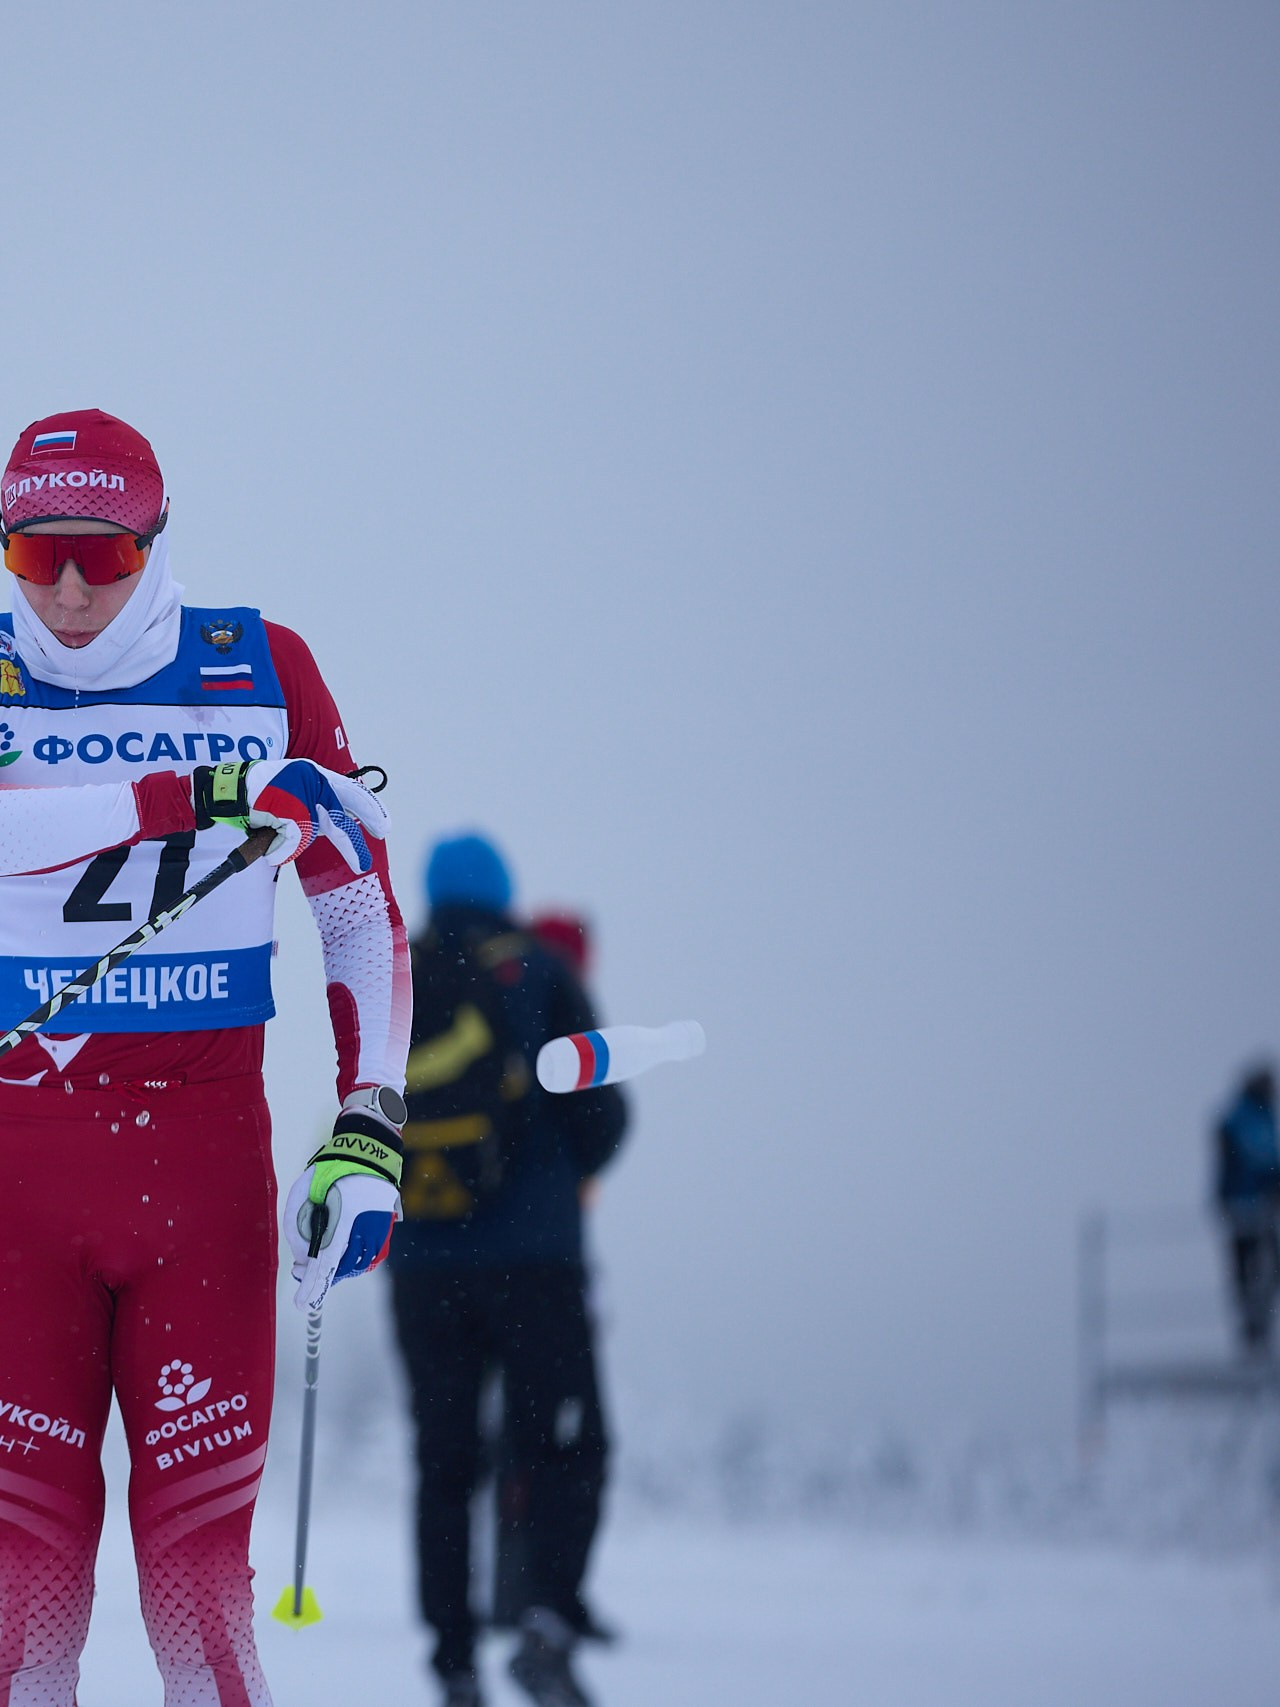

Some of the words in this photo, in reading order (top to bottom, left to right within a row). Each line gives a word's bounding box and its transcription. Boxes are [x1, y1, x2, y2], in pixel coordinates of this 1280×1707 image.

[17, 469, 125, 497] ЛУКОЙЛ
[33, 732, 269, 765] ФОСАГРО
[145, 1394, 248, 1446] ФОСАГРО
[155, 1420, 253, 1471] BIVIUM
